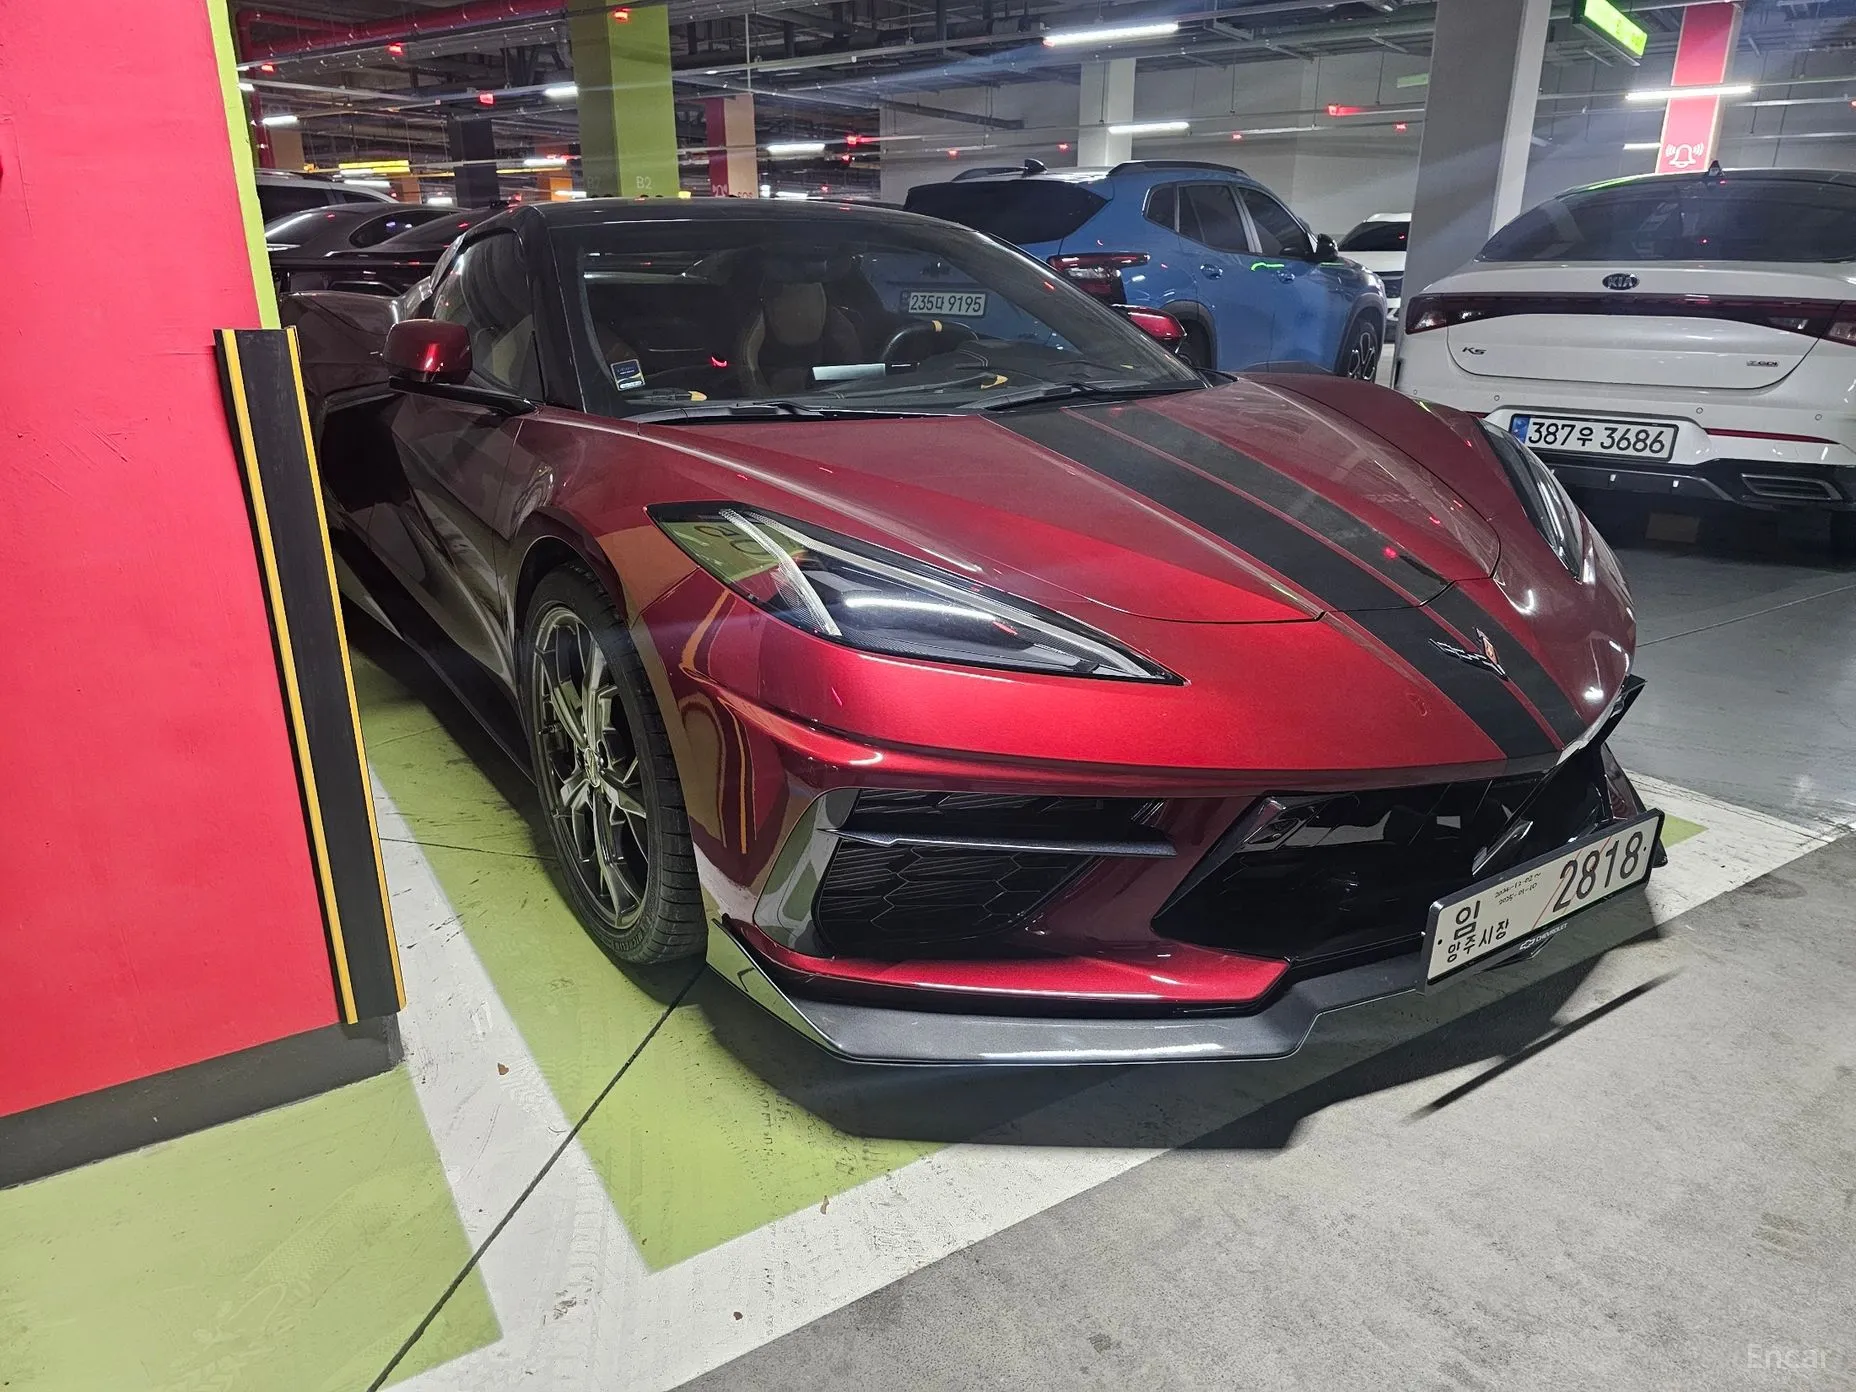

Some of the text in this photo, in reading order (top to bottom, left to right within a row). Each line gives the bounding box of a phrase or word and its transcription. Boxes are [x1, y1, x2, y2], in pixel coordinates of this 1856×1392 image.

[636, 176, 652, 190] B2
[1608, 276, 1633, 288] KIA
[948, 295, 982, 313] 9195
[1528, 422, 1665, 454] 387우 3686
[1553, 831, 1643, 912] 2818
[1454, 900, 1480, 940] 임
